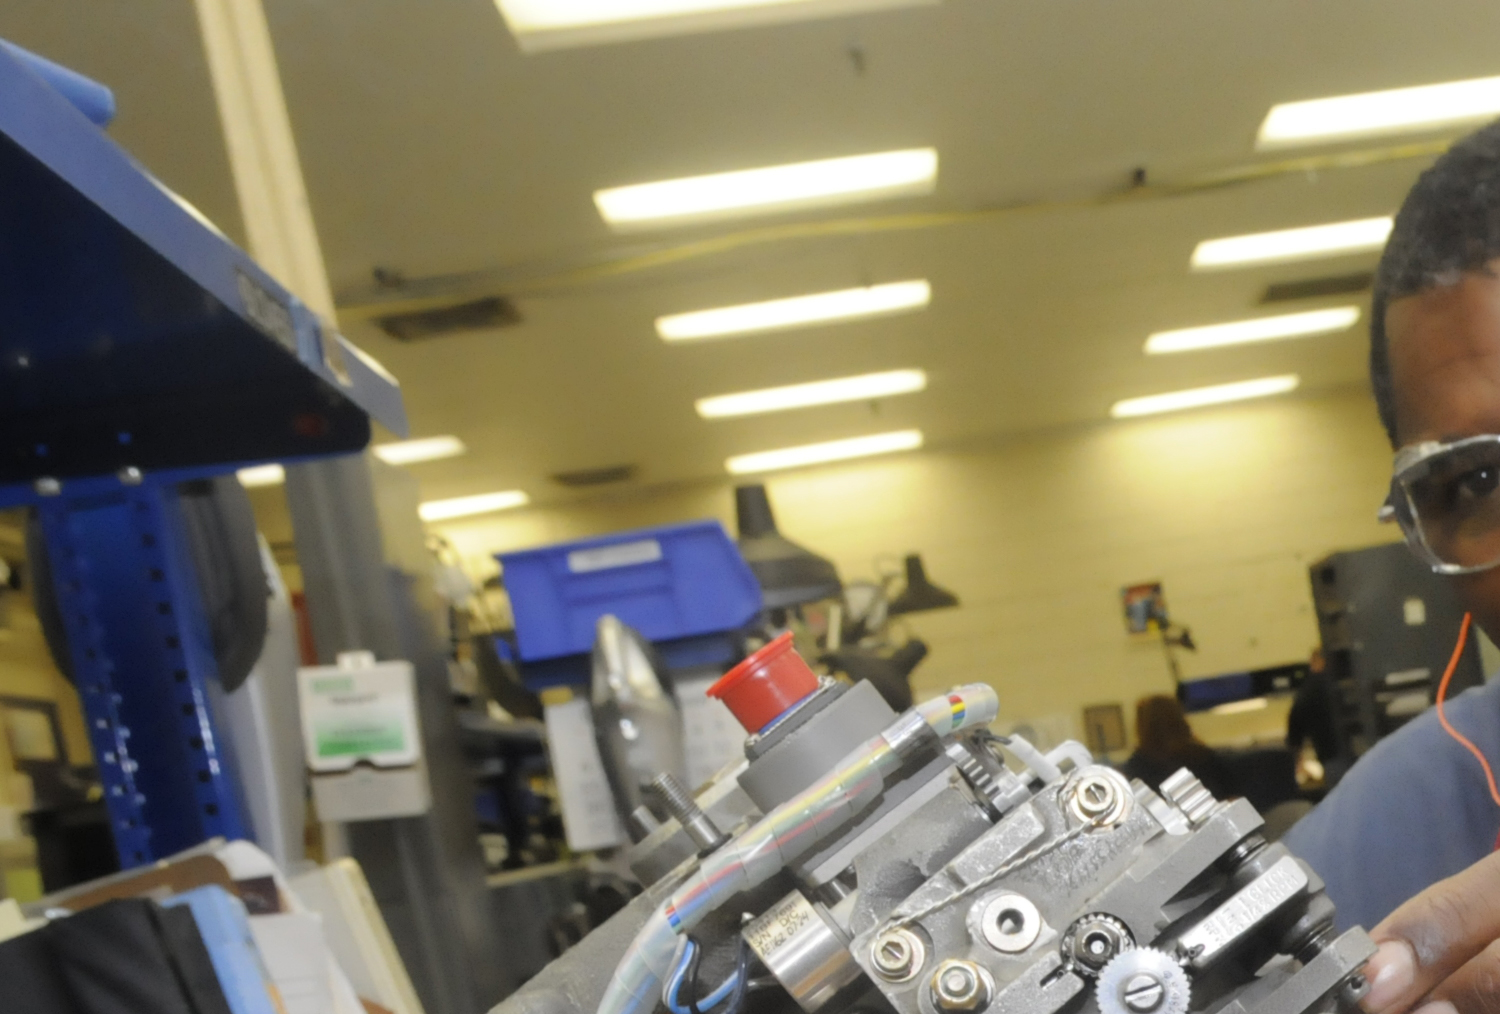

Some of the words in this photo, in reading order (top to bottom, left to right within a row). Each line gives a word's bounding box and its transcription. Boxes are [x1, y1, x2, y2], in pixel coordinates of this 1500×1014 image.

[1248, 867, 1288, 901] CLICK
[1268, 873, 1299, 902] RPM
[779, 910, 799, 927] D/C
